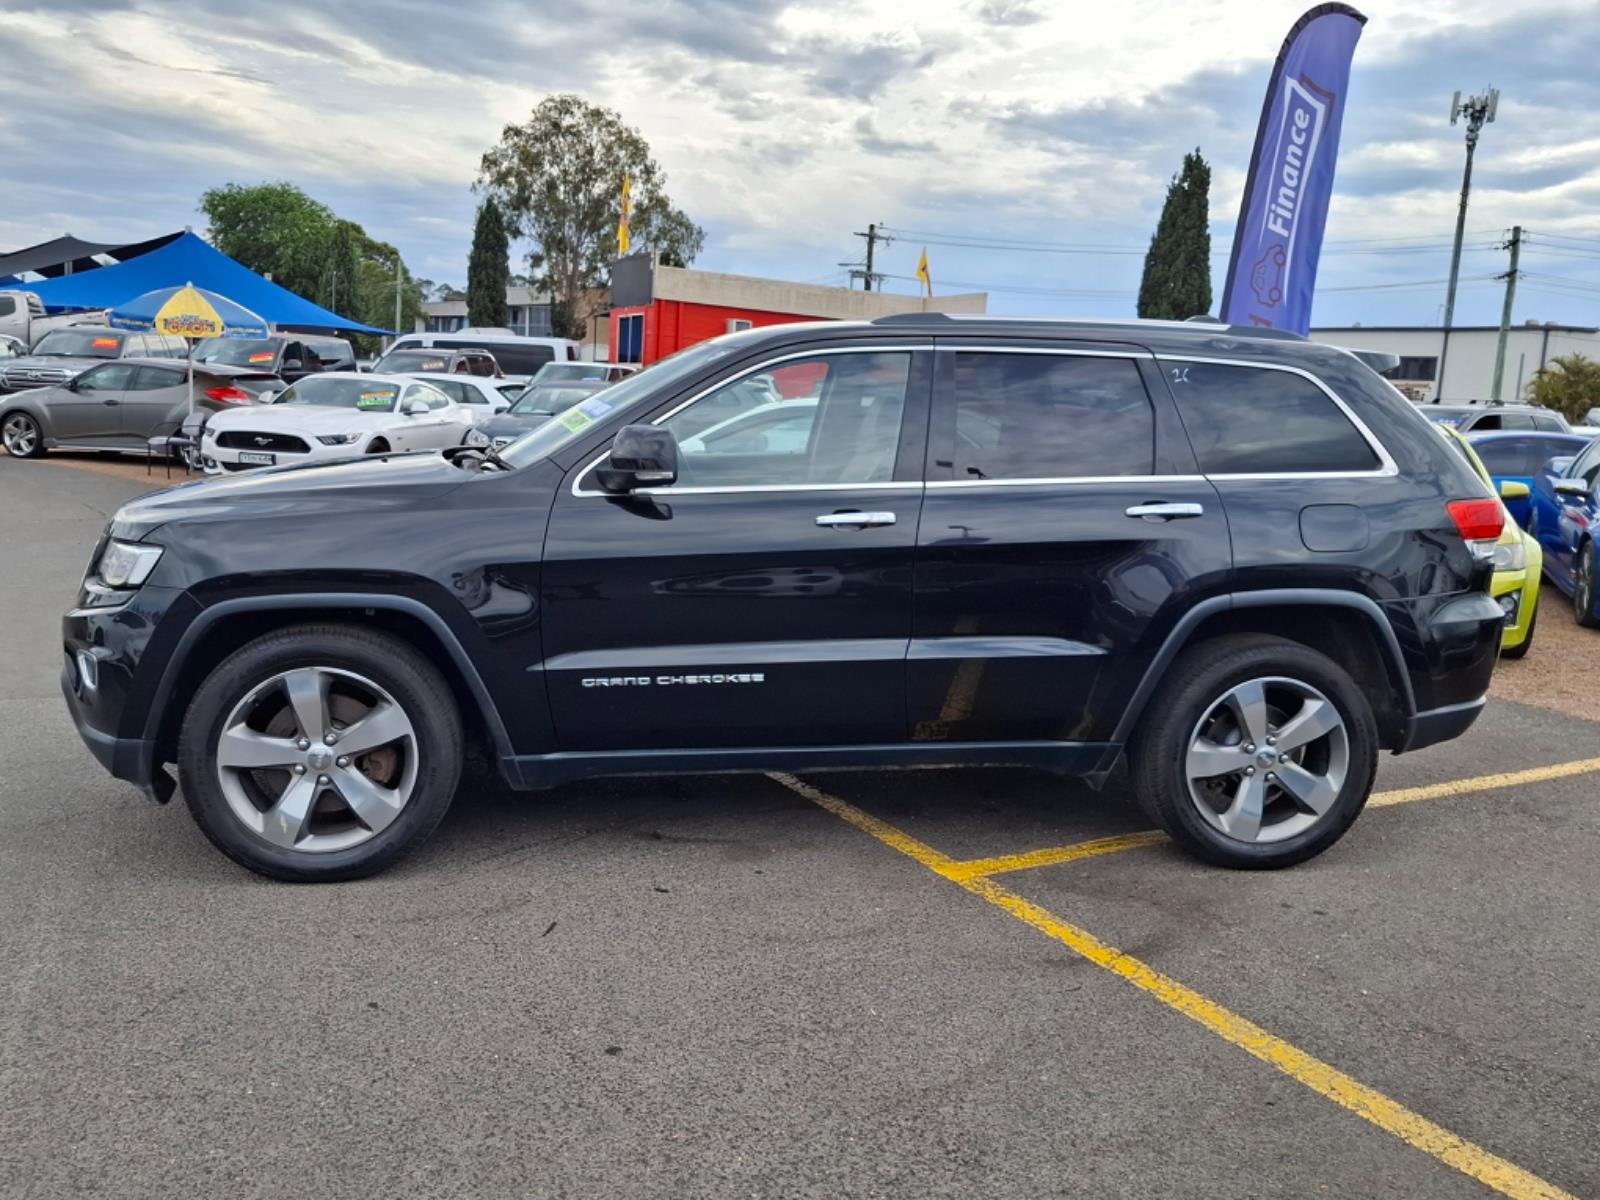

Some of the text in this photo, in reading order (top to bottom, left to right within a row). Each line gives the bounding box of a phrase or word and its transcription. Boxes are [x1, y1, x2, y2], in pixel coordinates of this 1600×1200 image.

[1267, 107, 1310, 237] Finance
[581, 673, 765, 687] GRAND CHEROKEE
